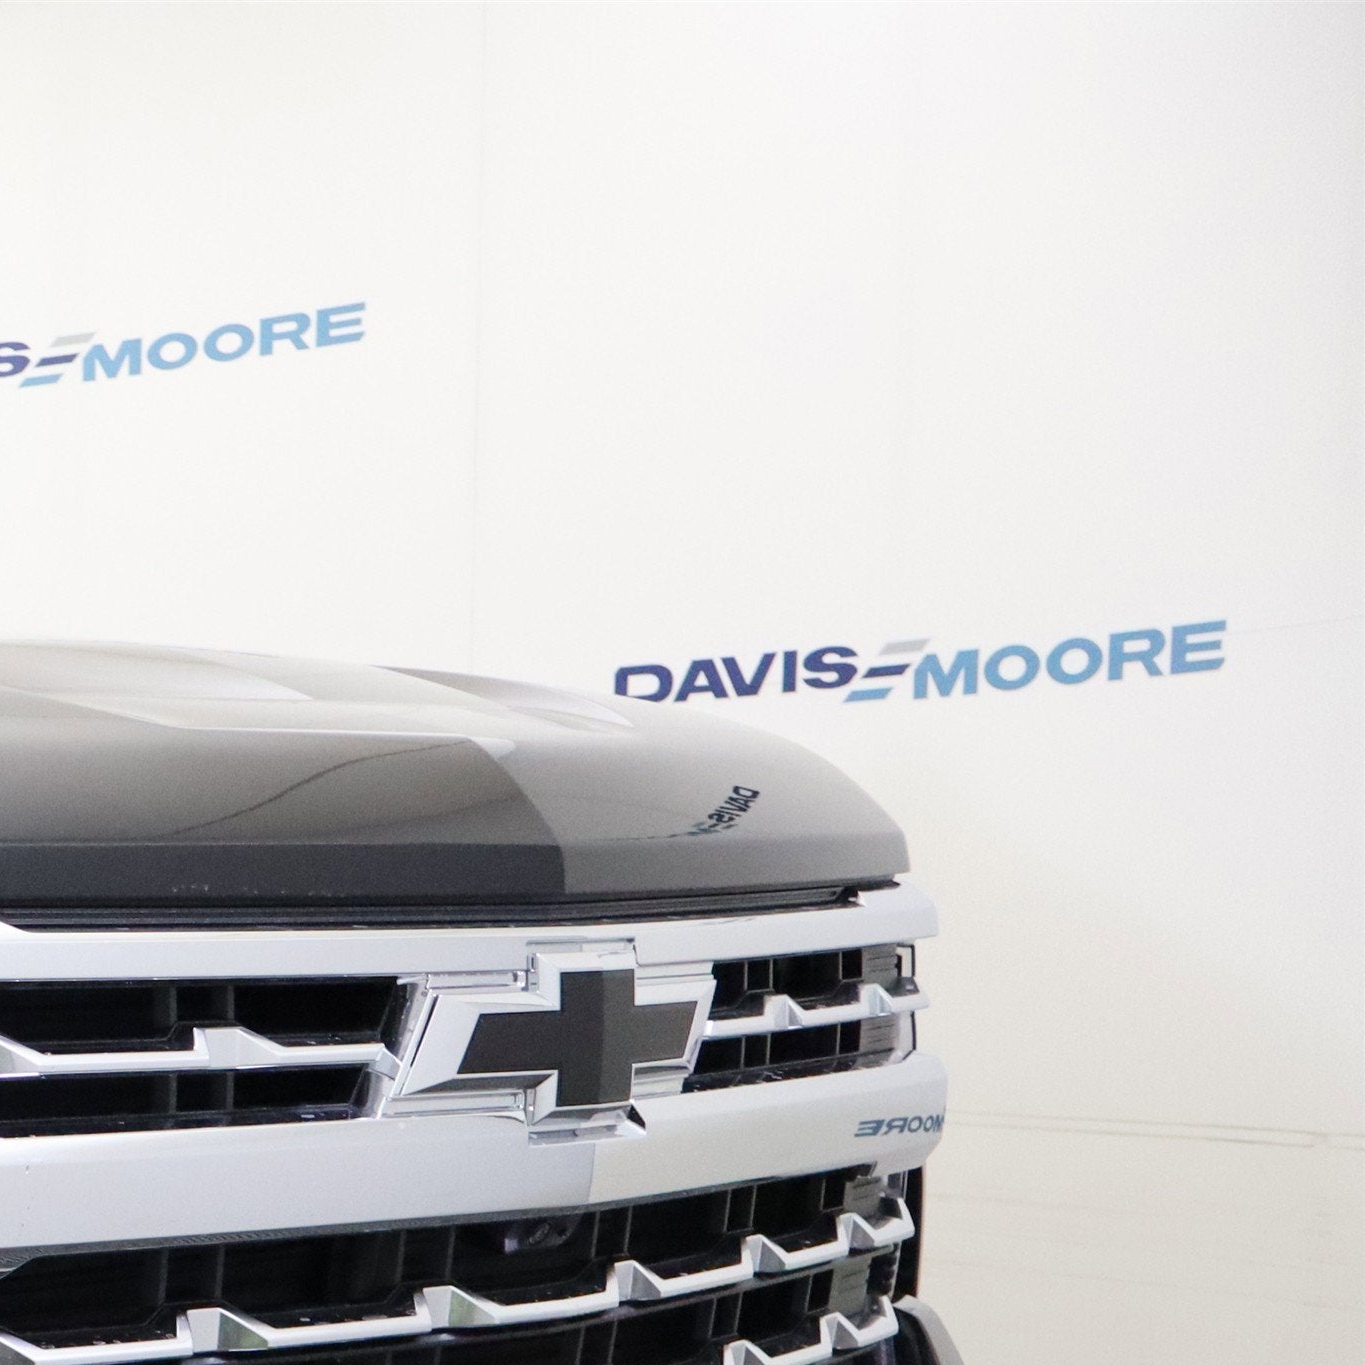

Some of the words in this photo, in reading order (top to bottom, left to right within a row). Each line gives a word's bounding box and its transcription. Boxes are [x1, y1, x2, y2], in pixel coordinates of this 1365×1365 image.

[81, 301, 367, 383] MOORE
[613, 645, 859, 704] DAVIS
[913, 619, 1227, 700] MOORE
